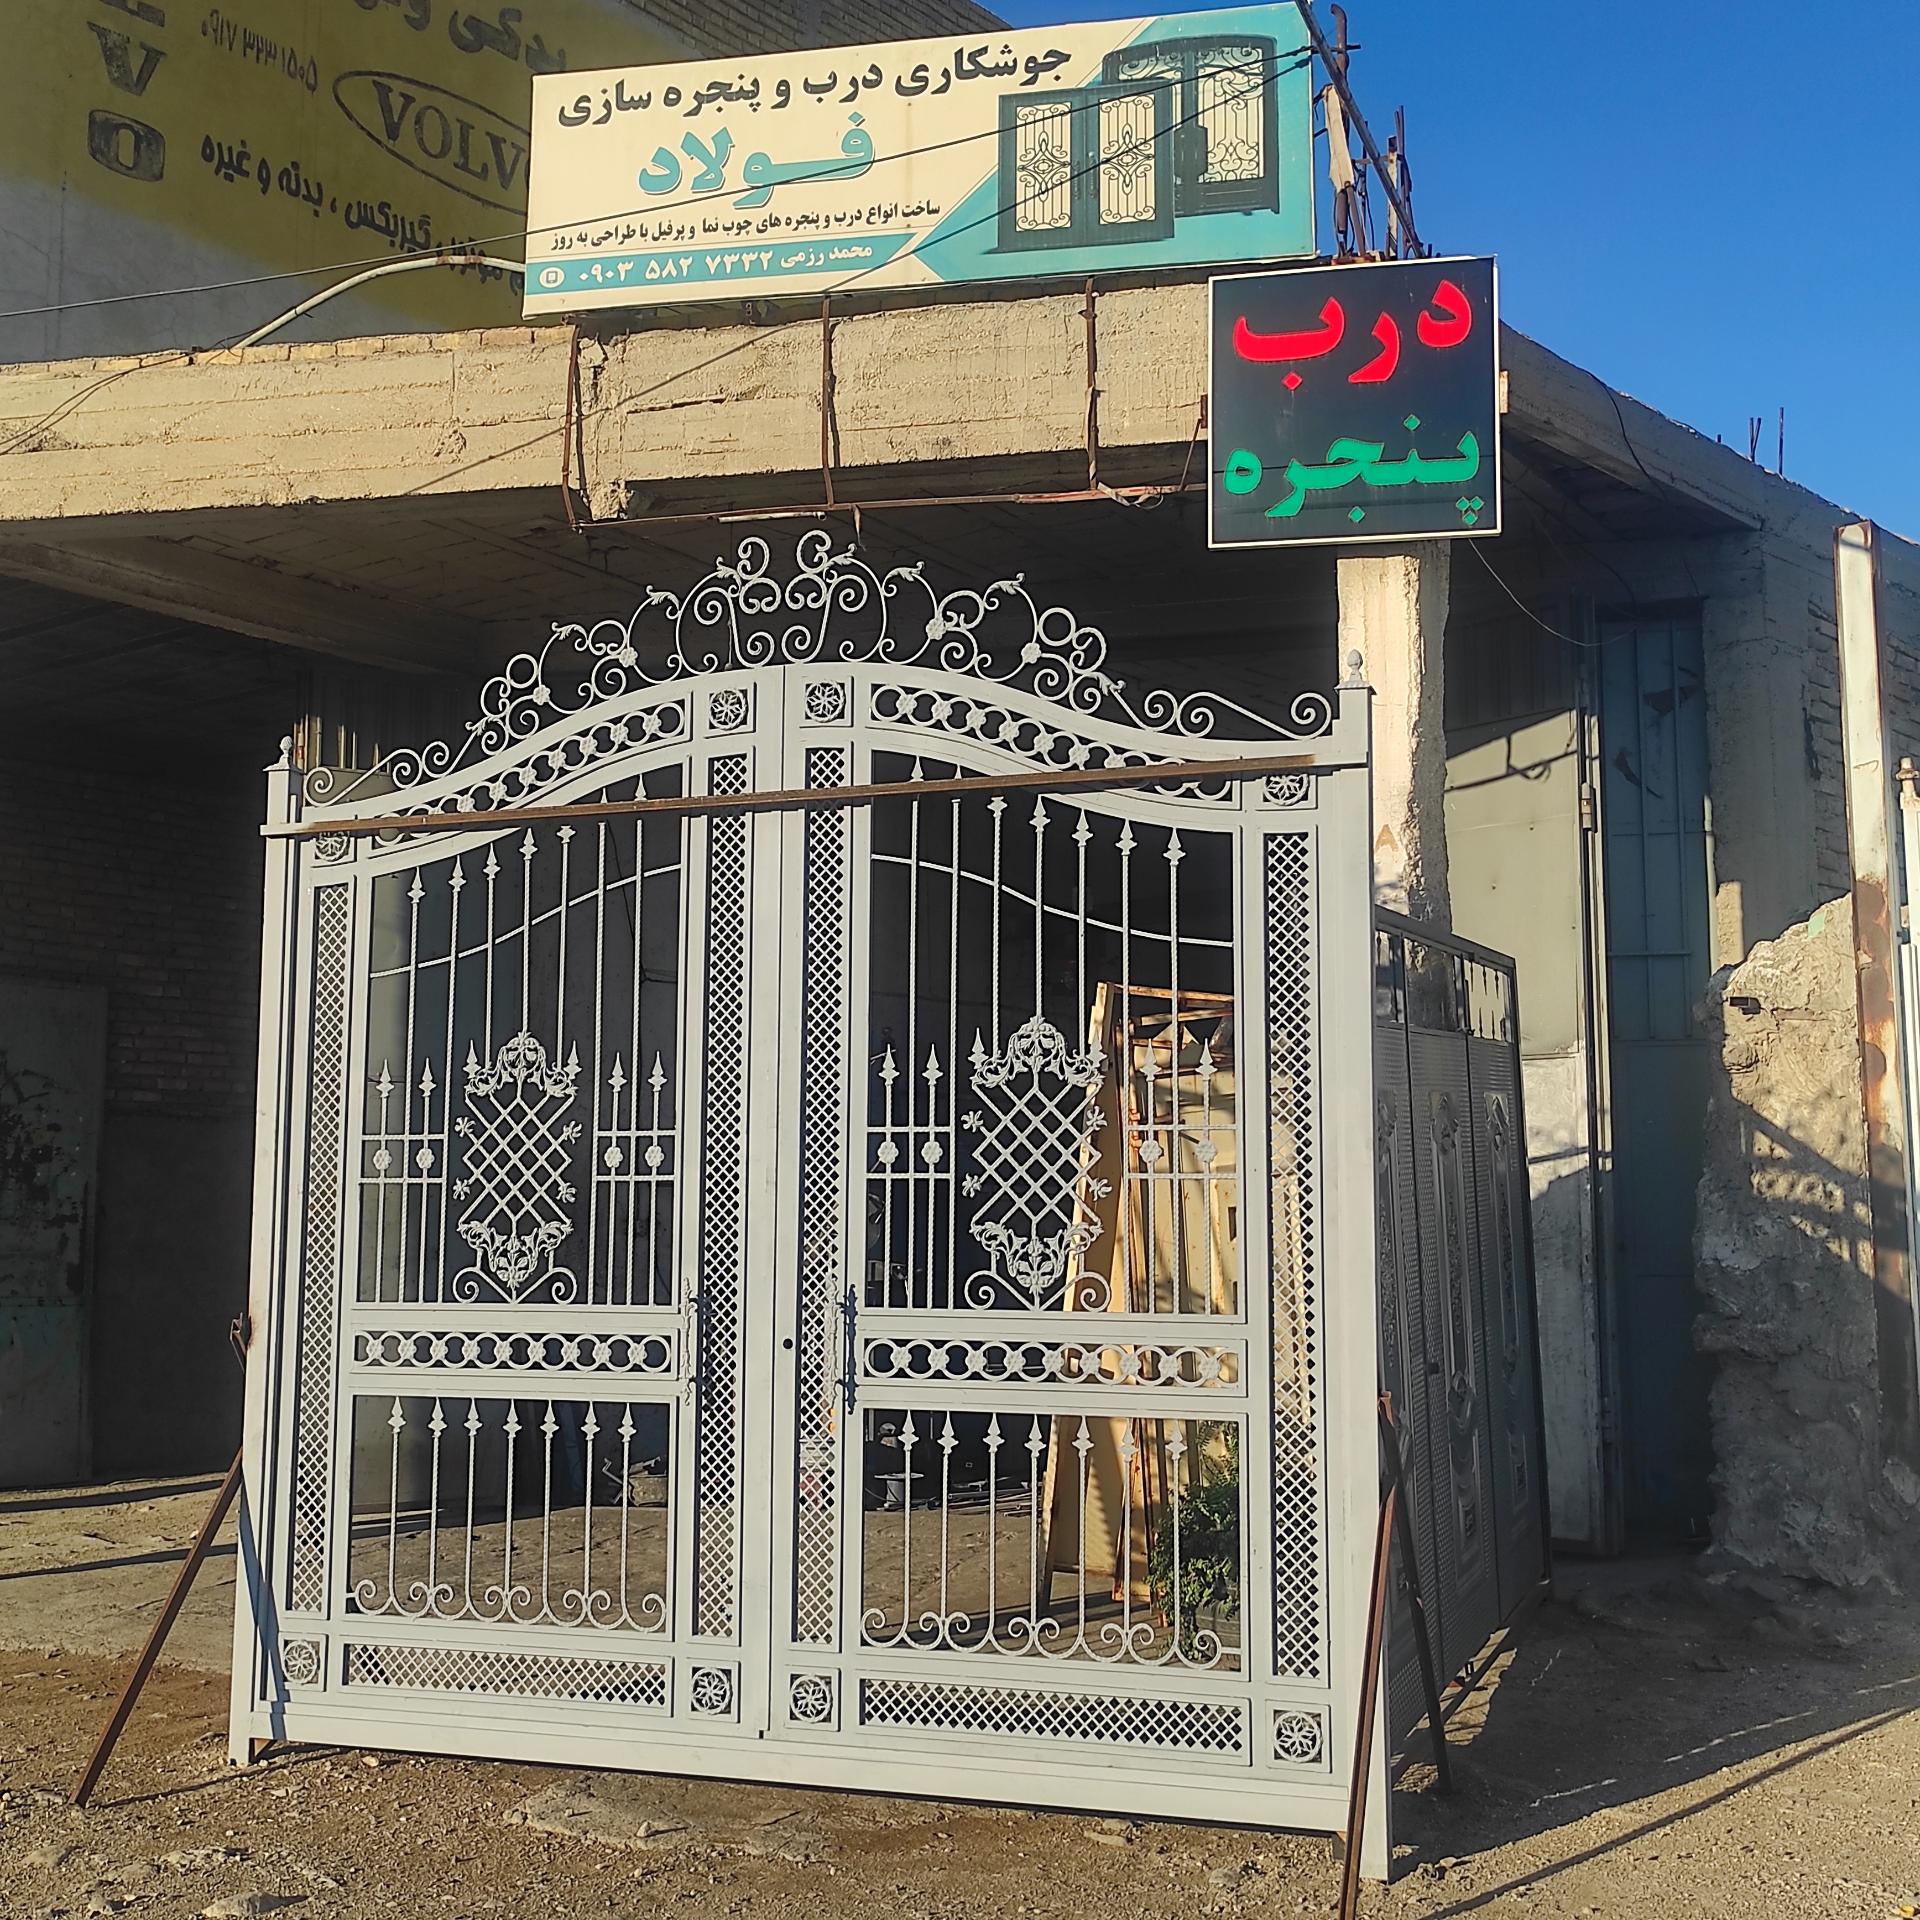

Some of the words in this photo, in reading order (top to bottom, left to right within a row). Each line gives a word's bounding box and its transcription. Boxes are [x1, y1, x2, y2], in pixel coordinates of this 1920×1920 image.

[895, 44, 1072, 98] جوشکاری
[663, 73, 761, 116] پنجره
[771, 76, 791, 110] و
[803, 63, 883, 104] درب
[558, 79, 652, 127] سازی
[372, 79, 529, 191] VOLV
[201, 134, 251, 183] غیره
[639, 111, 876, 209] فولاد
[256, 157, 271, 195] و
[833, 208, 863, 227] درب
[865, 202, 898, 225] انواع
[901, 199, 941, 218] ساخت
[639, 223, 649, 238] با
[651, 221, 685, 242] پرفیل
[687, 225, 696, 240] و
[702, 216, 719, 233] نما
[722, 219, 753, 236] چوب
[755, 212, 782, 234] های
[784, 211, 820, 232] پنجره
[823, 215, 831, 229] و
[551, 233, 574, 251] روز
[576, 231, 588, 247] به
[590, 223, 636, 247] طراحی
[705, 250, 774, 275] ۷۳۳۲
[780, 247, 825, 269] رزمی
[828, 244, 873, 260] محمد
[579, 261, 634, 284] ۰۹۰۳
[644, 255, 693, 280] ۵۸۲
[1232, 279, 1472, 390] درب
[1222, 413, 1484, 525] پنجره
